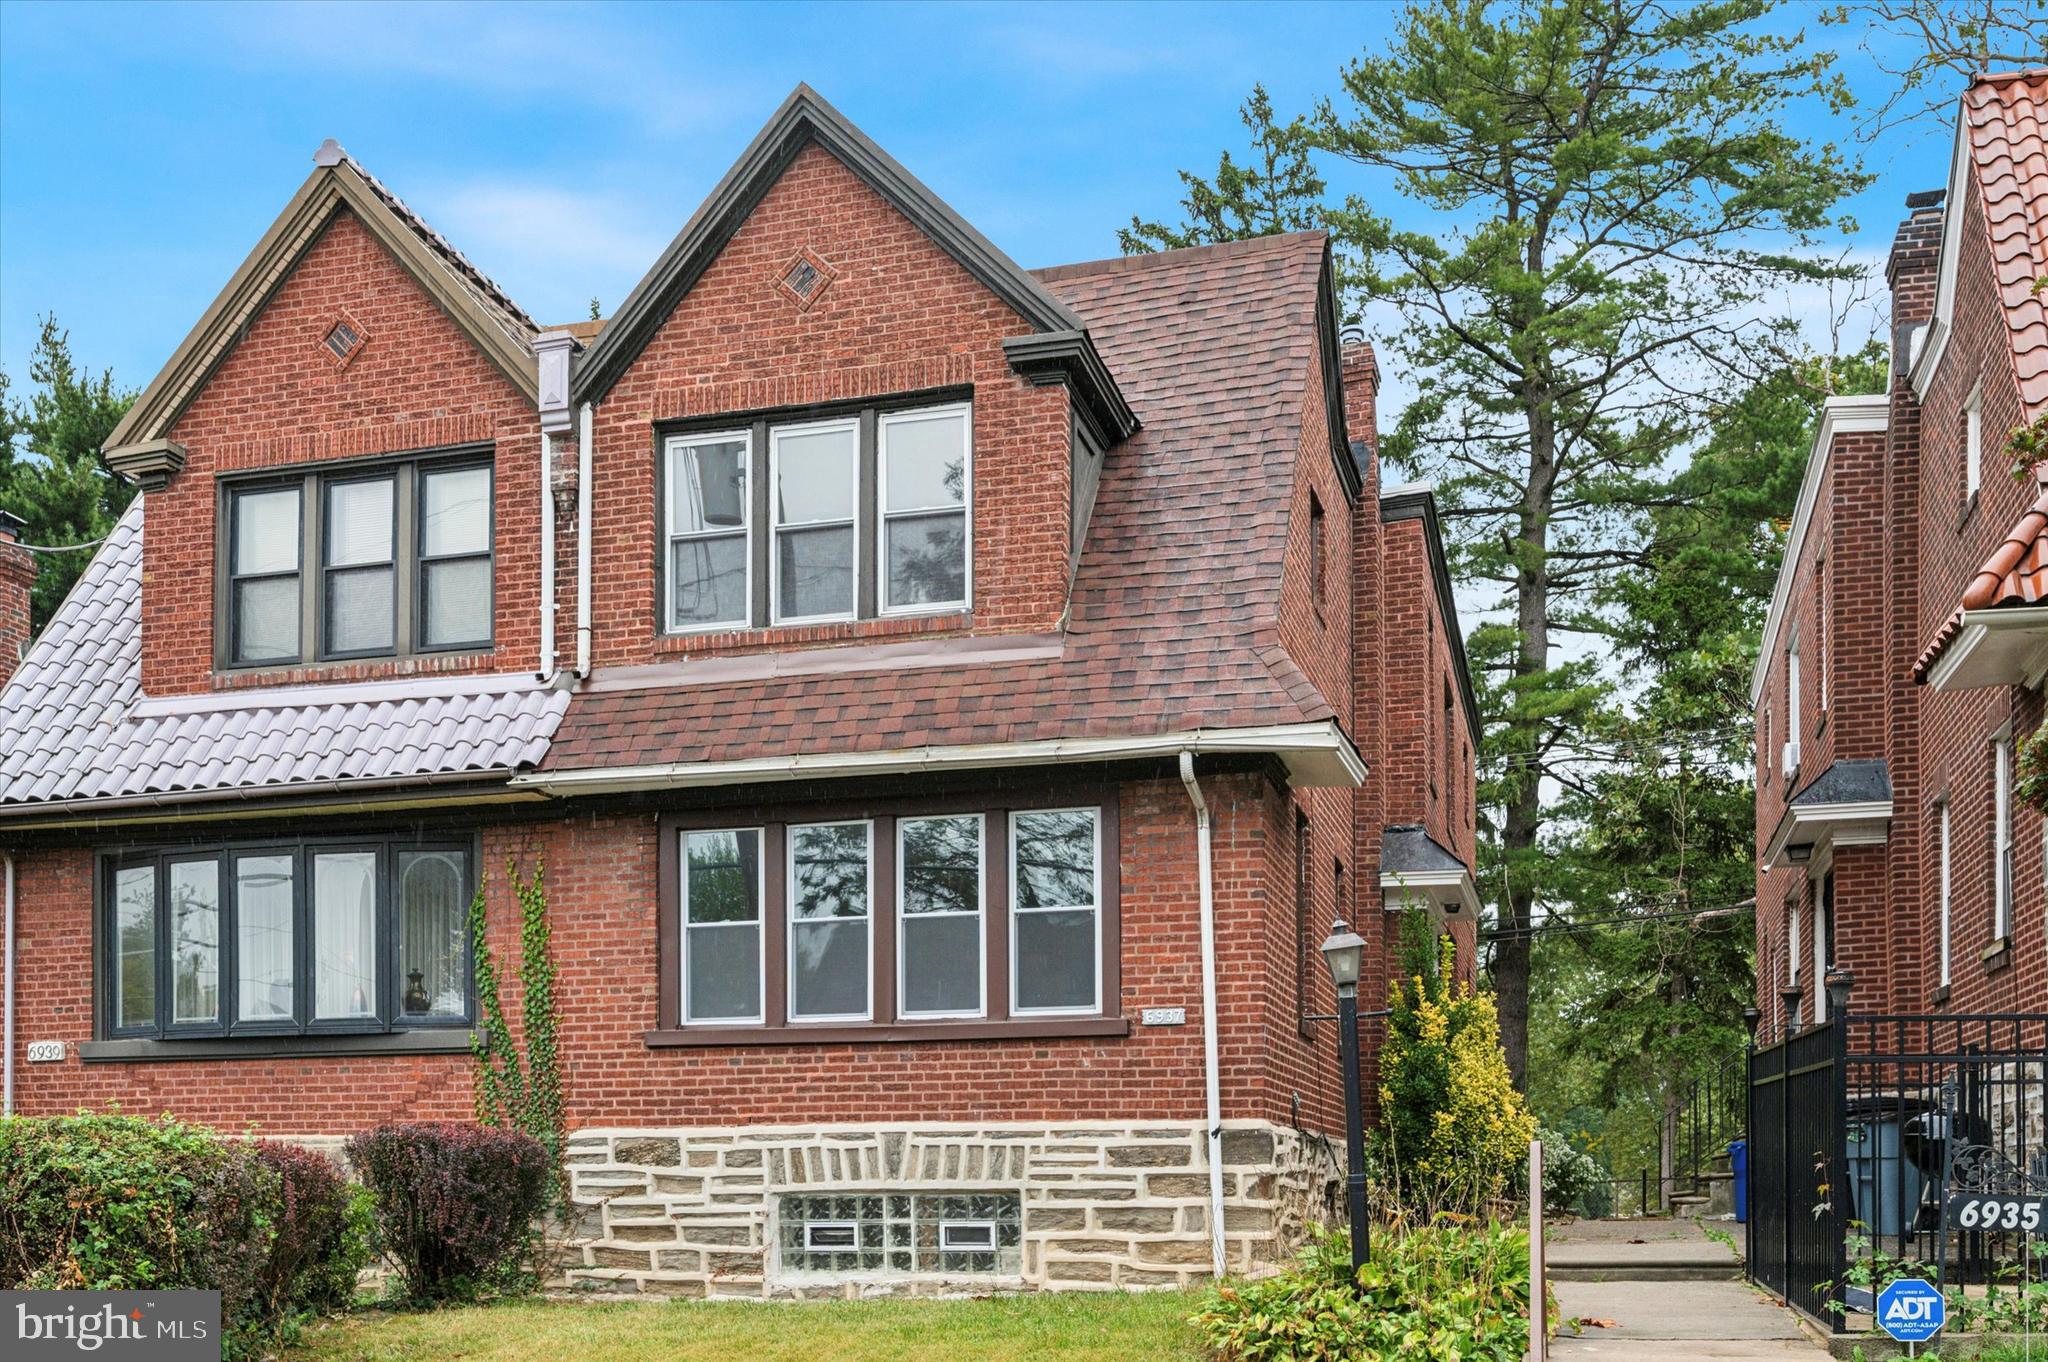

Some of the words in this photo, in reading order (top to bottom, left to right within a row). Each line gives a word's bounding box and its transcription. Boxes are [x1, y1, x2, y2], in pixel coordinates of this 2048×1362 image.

[1146, 1010, 1181, 1022] 6937
[29, 1045, 60, 1060] 6939
[1960, 1200, 2040, 1230] 6935
[1885, 1297, 1937, 1320] ADT
